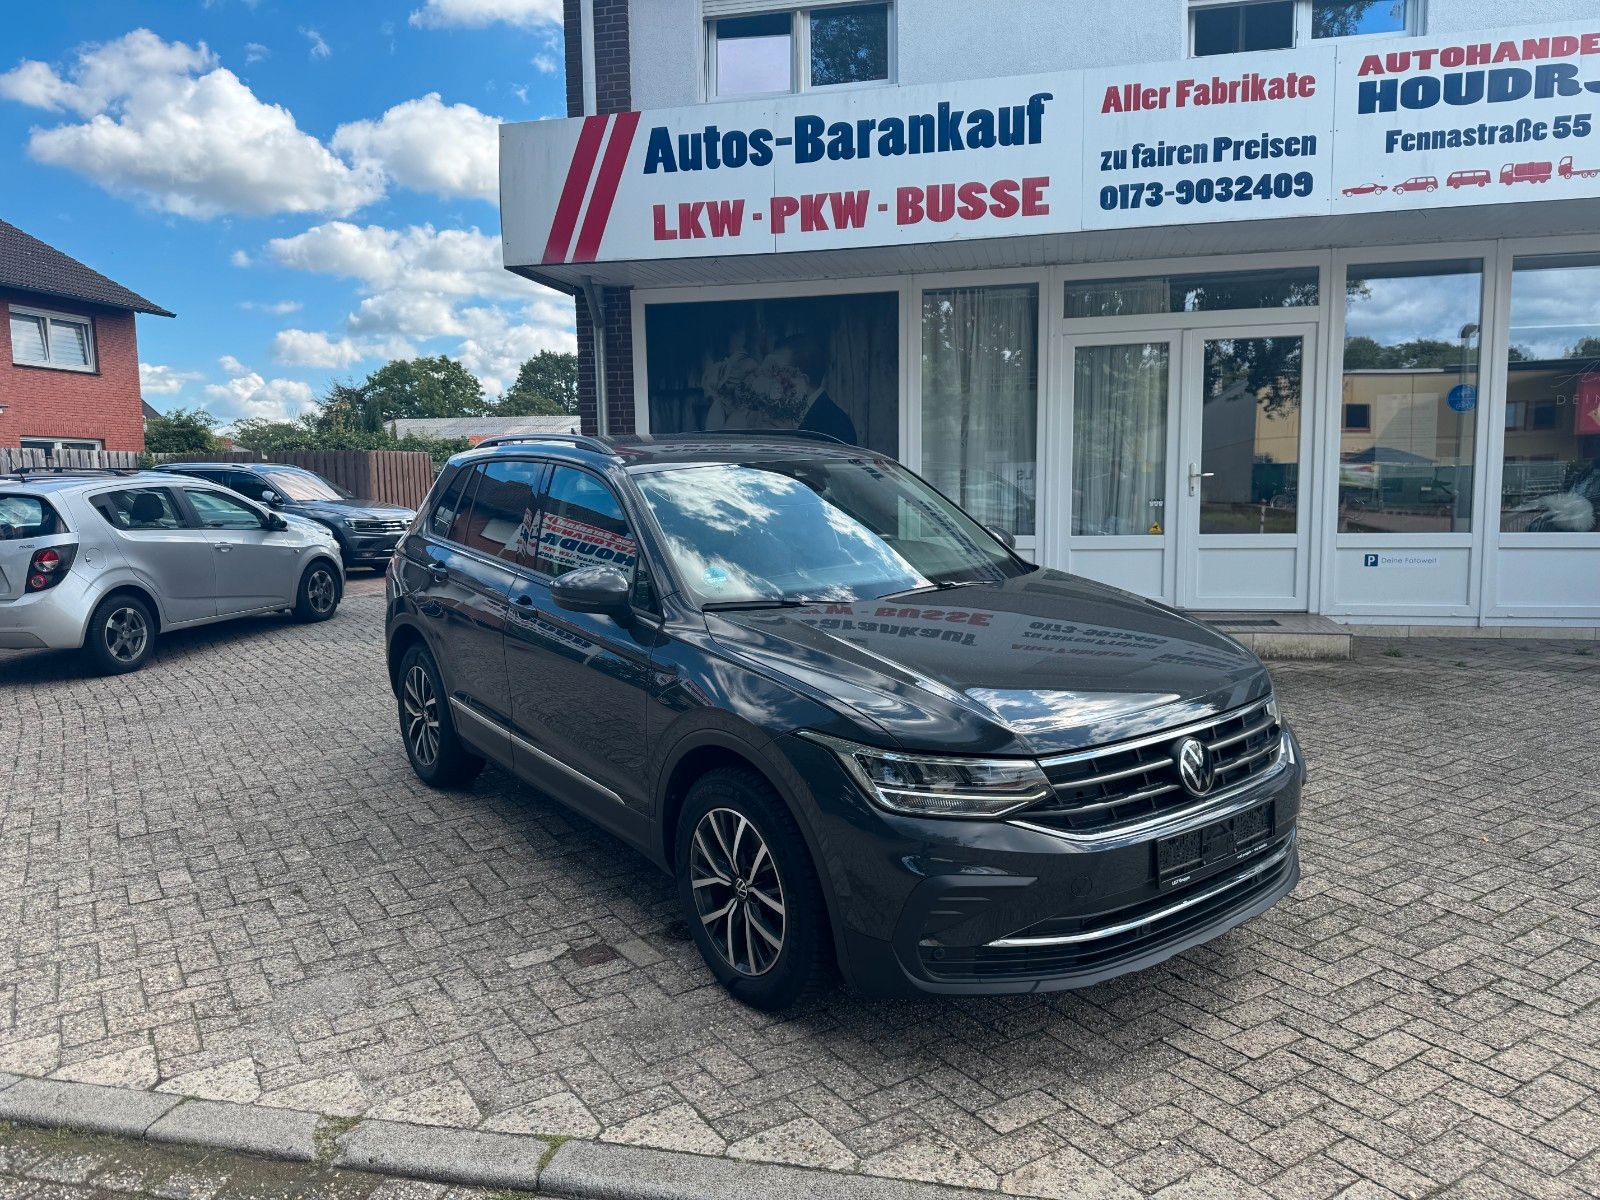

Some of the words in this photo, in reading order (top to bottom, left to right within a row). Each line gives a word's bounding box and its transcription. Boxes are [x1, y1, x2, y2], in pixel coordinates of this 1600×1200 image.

[1359, 33, 1600, 75] AUTOHANDE
[1101, 84, 1171, 114] Aller
[1175, 72, 1317, 107] Fabrikate
[643, 92, 1053, 175] Autos-Barankauf
[1100, 149, 1128, 172] zu
[1132, 138, 1209, 169] fairen
[1213, 132, 1317, 163] Preisen
[1385, 118, 1548, 153] Fennastraße
[1552, 114, 1592, 138] 55
[653, 199, 745, 240] LKW
[770, 189, 869, 234] PKW
[897, 177, 1050, 225] BUSSE
[1099, 171, 1314, 211] 0173-9032409
